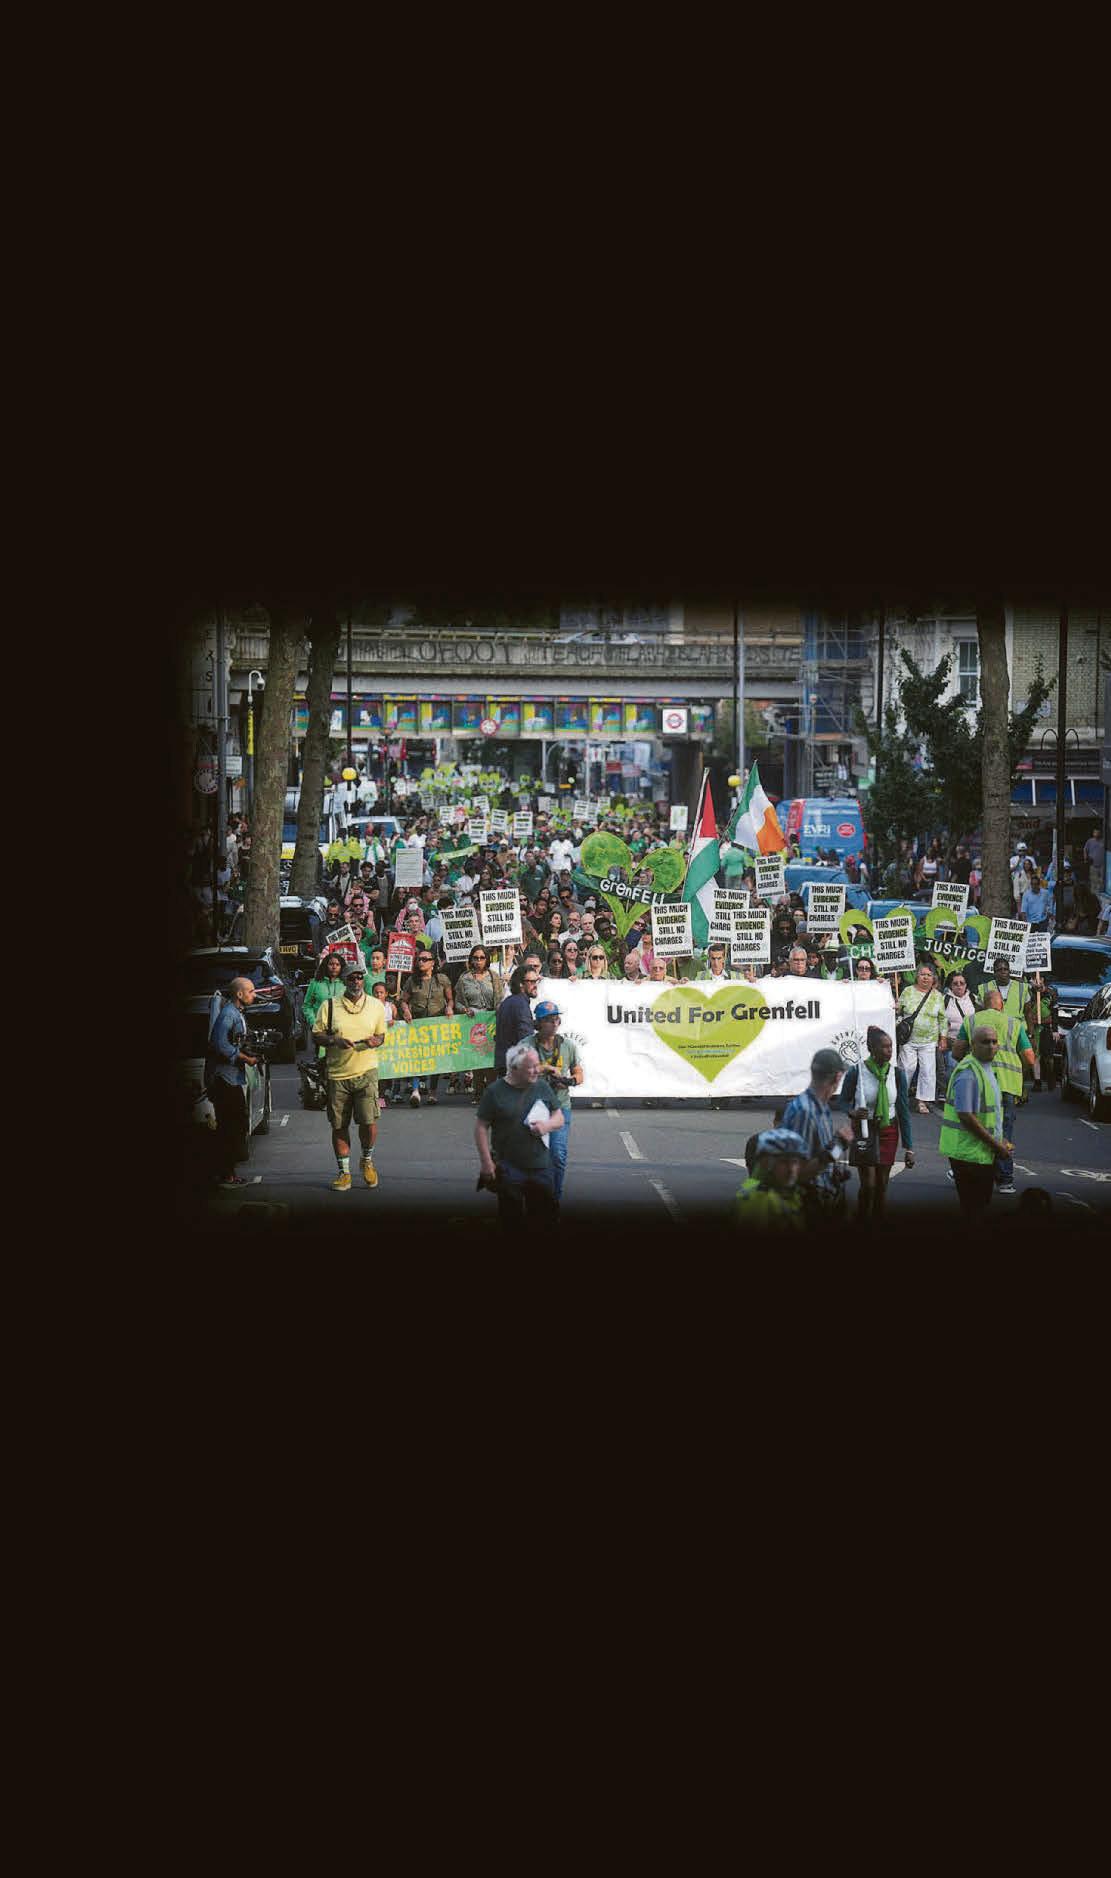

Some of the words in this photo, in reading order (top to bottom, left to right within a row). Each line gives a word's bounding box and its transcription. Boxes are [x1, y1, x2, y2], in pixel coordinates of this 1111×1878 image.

[936, 883, 949, 892] THIS
[949, 884, 967, 893] MUCH
[482, 893, 496, 901] THIS
[497, 891, 517, 900] MUCH
[713, 890, 727, 899] THIS
[728, 891, 747, 900] MUCH
[936, 893, 963, 902] EVIDENCE
[485, 902, 515, 912] EVIDENCE
[654, 906, 667, 914] THIS
[668, 904, 688, 913] MUCH
[441, 911, 454, 919] THIS
[455, 909, 474, 918] MUCH
[487, 913, 504, 922] STILL
[505, 912, 514, 921] NO
[733, 911, 747, 919] THIS
[748, 910, 767, 919] MUCH
[445, 919, 473, 930] EVIDENCE
[656, 915, 687, 924] EVIDENCE
[875, 920, 889, 929] THIS
[890, 918, 910, 927] MUCH
[483, 924, 512, 933] CHARGES
[658, 927, 675, 935] STILL
[676, 925, 685, 934] NO
[735, 921, 765, 930] EVIDENCE
[447, 930, 464, 940] STILL
[464, 930, 474, 938] NO
[736, 932, 753, 941] STILL
[754, 932, 763, 941] NO
[878, 928, 908, 940] EVIDENCE
[445, 940, 472, 950] CHARGES
[654, 936, 683, 946] CHARGES
[880, 942, 897, 950] STILL
[898, 940, 908, 948] NO
[732, 943, 761, 952] CHARGES
[876, 951, 905, 961] CHARGES
[607, 1004, 681, 1024] United
[688, 1006, 726, 1024] For
[731, 1000, 821, 1021] Grenfell
[384, 1023, 463, 1047] NCASTER
